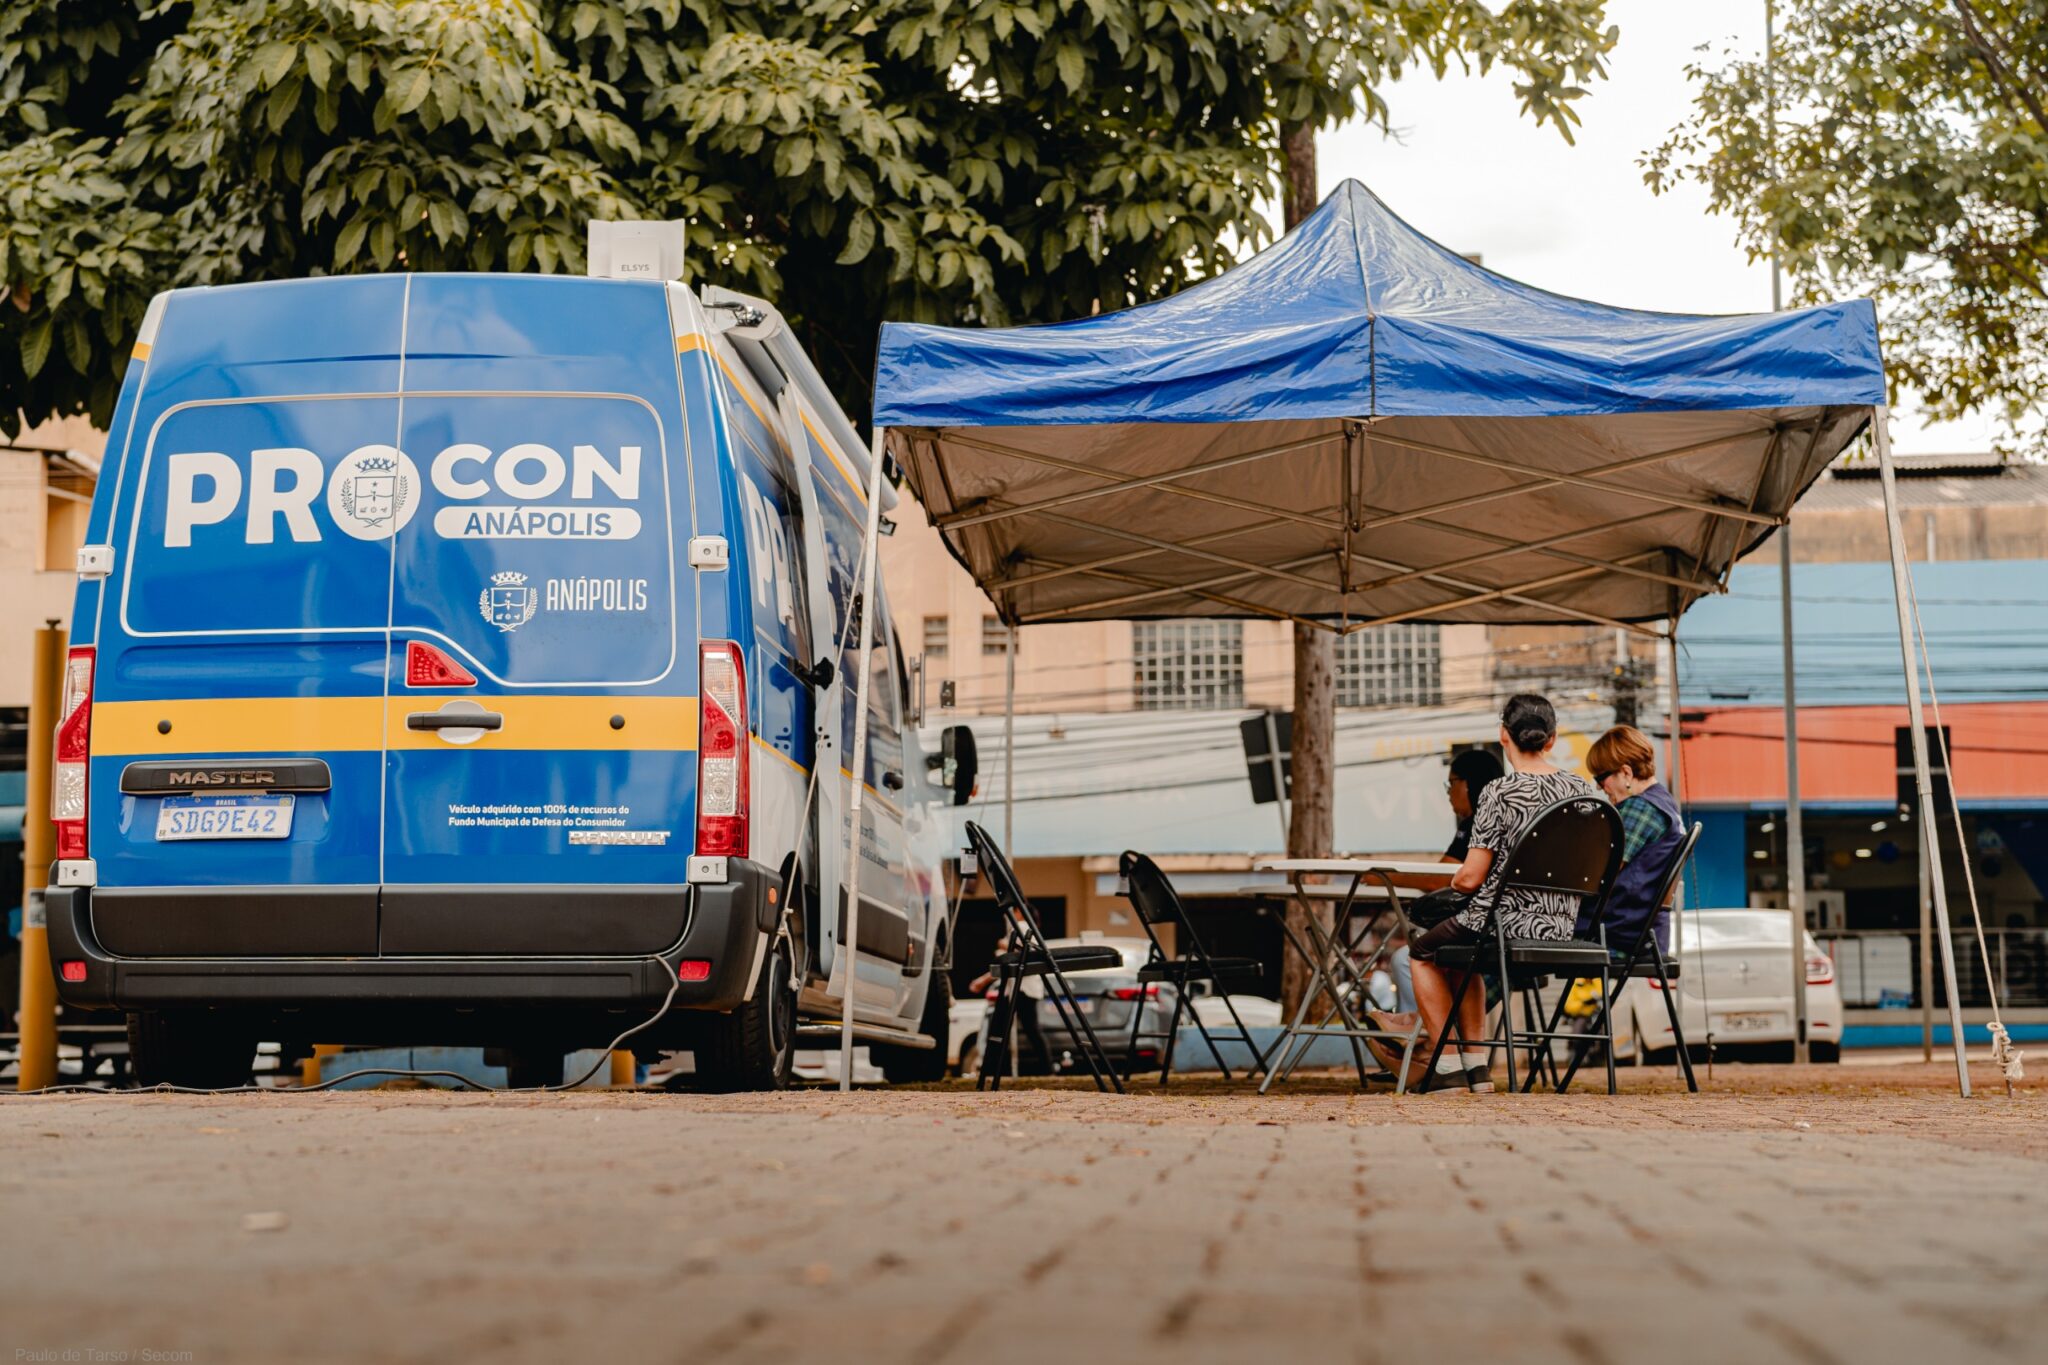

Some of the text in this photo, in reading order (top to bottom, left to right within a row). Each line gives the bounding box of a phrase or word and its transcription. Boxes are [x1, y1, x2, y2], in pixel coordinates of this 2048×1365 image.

[621, 264, 650, 272] ELSYS
[463, 506, 612, 536] ANÁPOLIS
[546, 575, 648, 611] ANÁPOLIS
[169, 771, 275, 785] MASTER
[449, 804, 630, 815] Veículo adquirido com 100% de recursos do
[170, 809, 277, 834] SDG9E42
[448, 817, 626, 828] Fundo Municipal de Defesa do Consumidor
[568, 831, 671, 845] RENAULT
